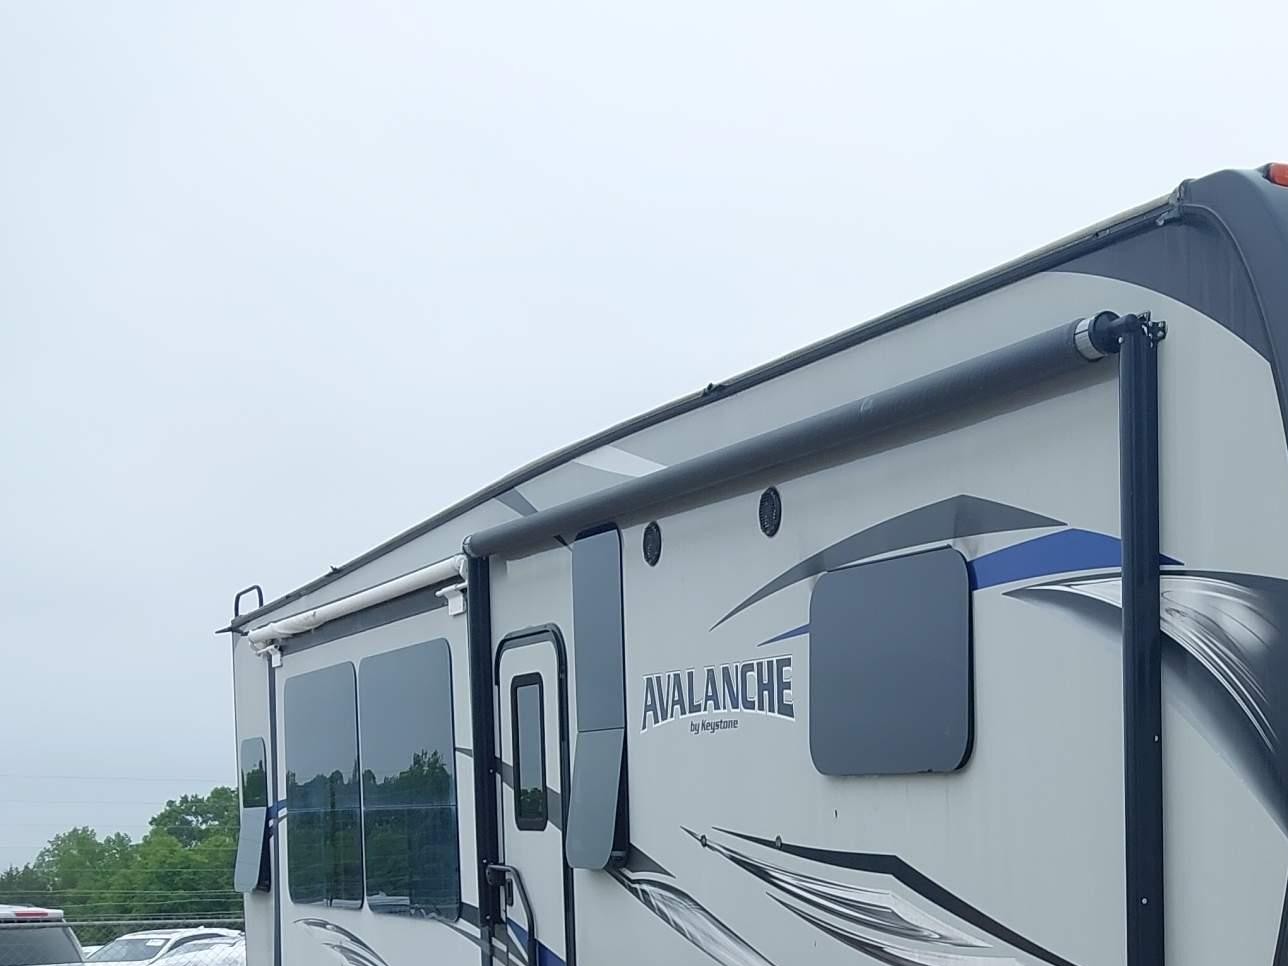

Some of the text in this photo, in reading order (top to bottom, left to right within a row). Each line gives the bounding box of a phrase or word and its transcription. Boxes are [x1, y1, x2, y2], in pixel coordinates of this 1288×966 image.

[640, 654, 796, 734] AVALANCHE
[690, 718, 739, 735] by Keystone
